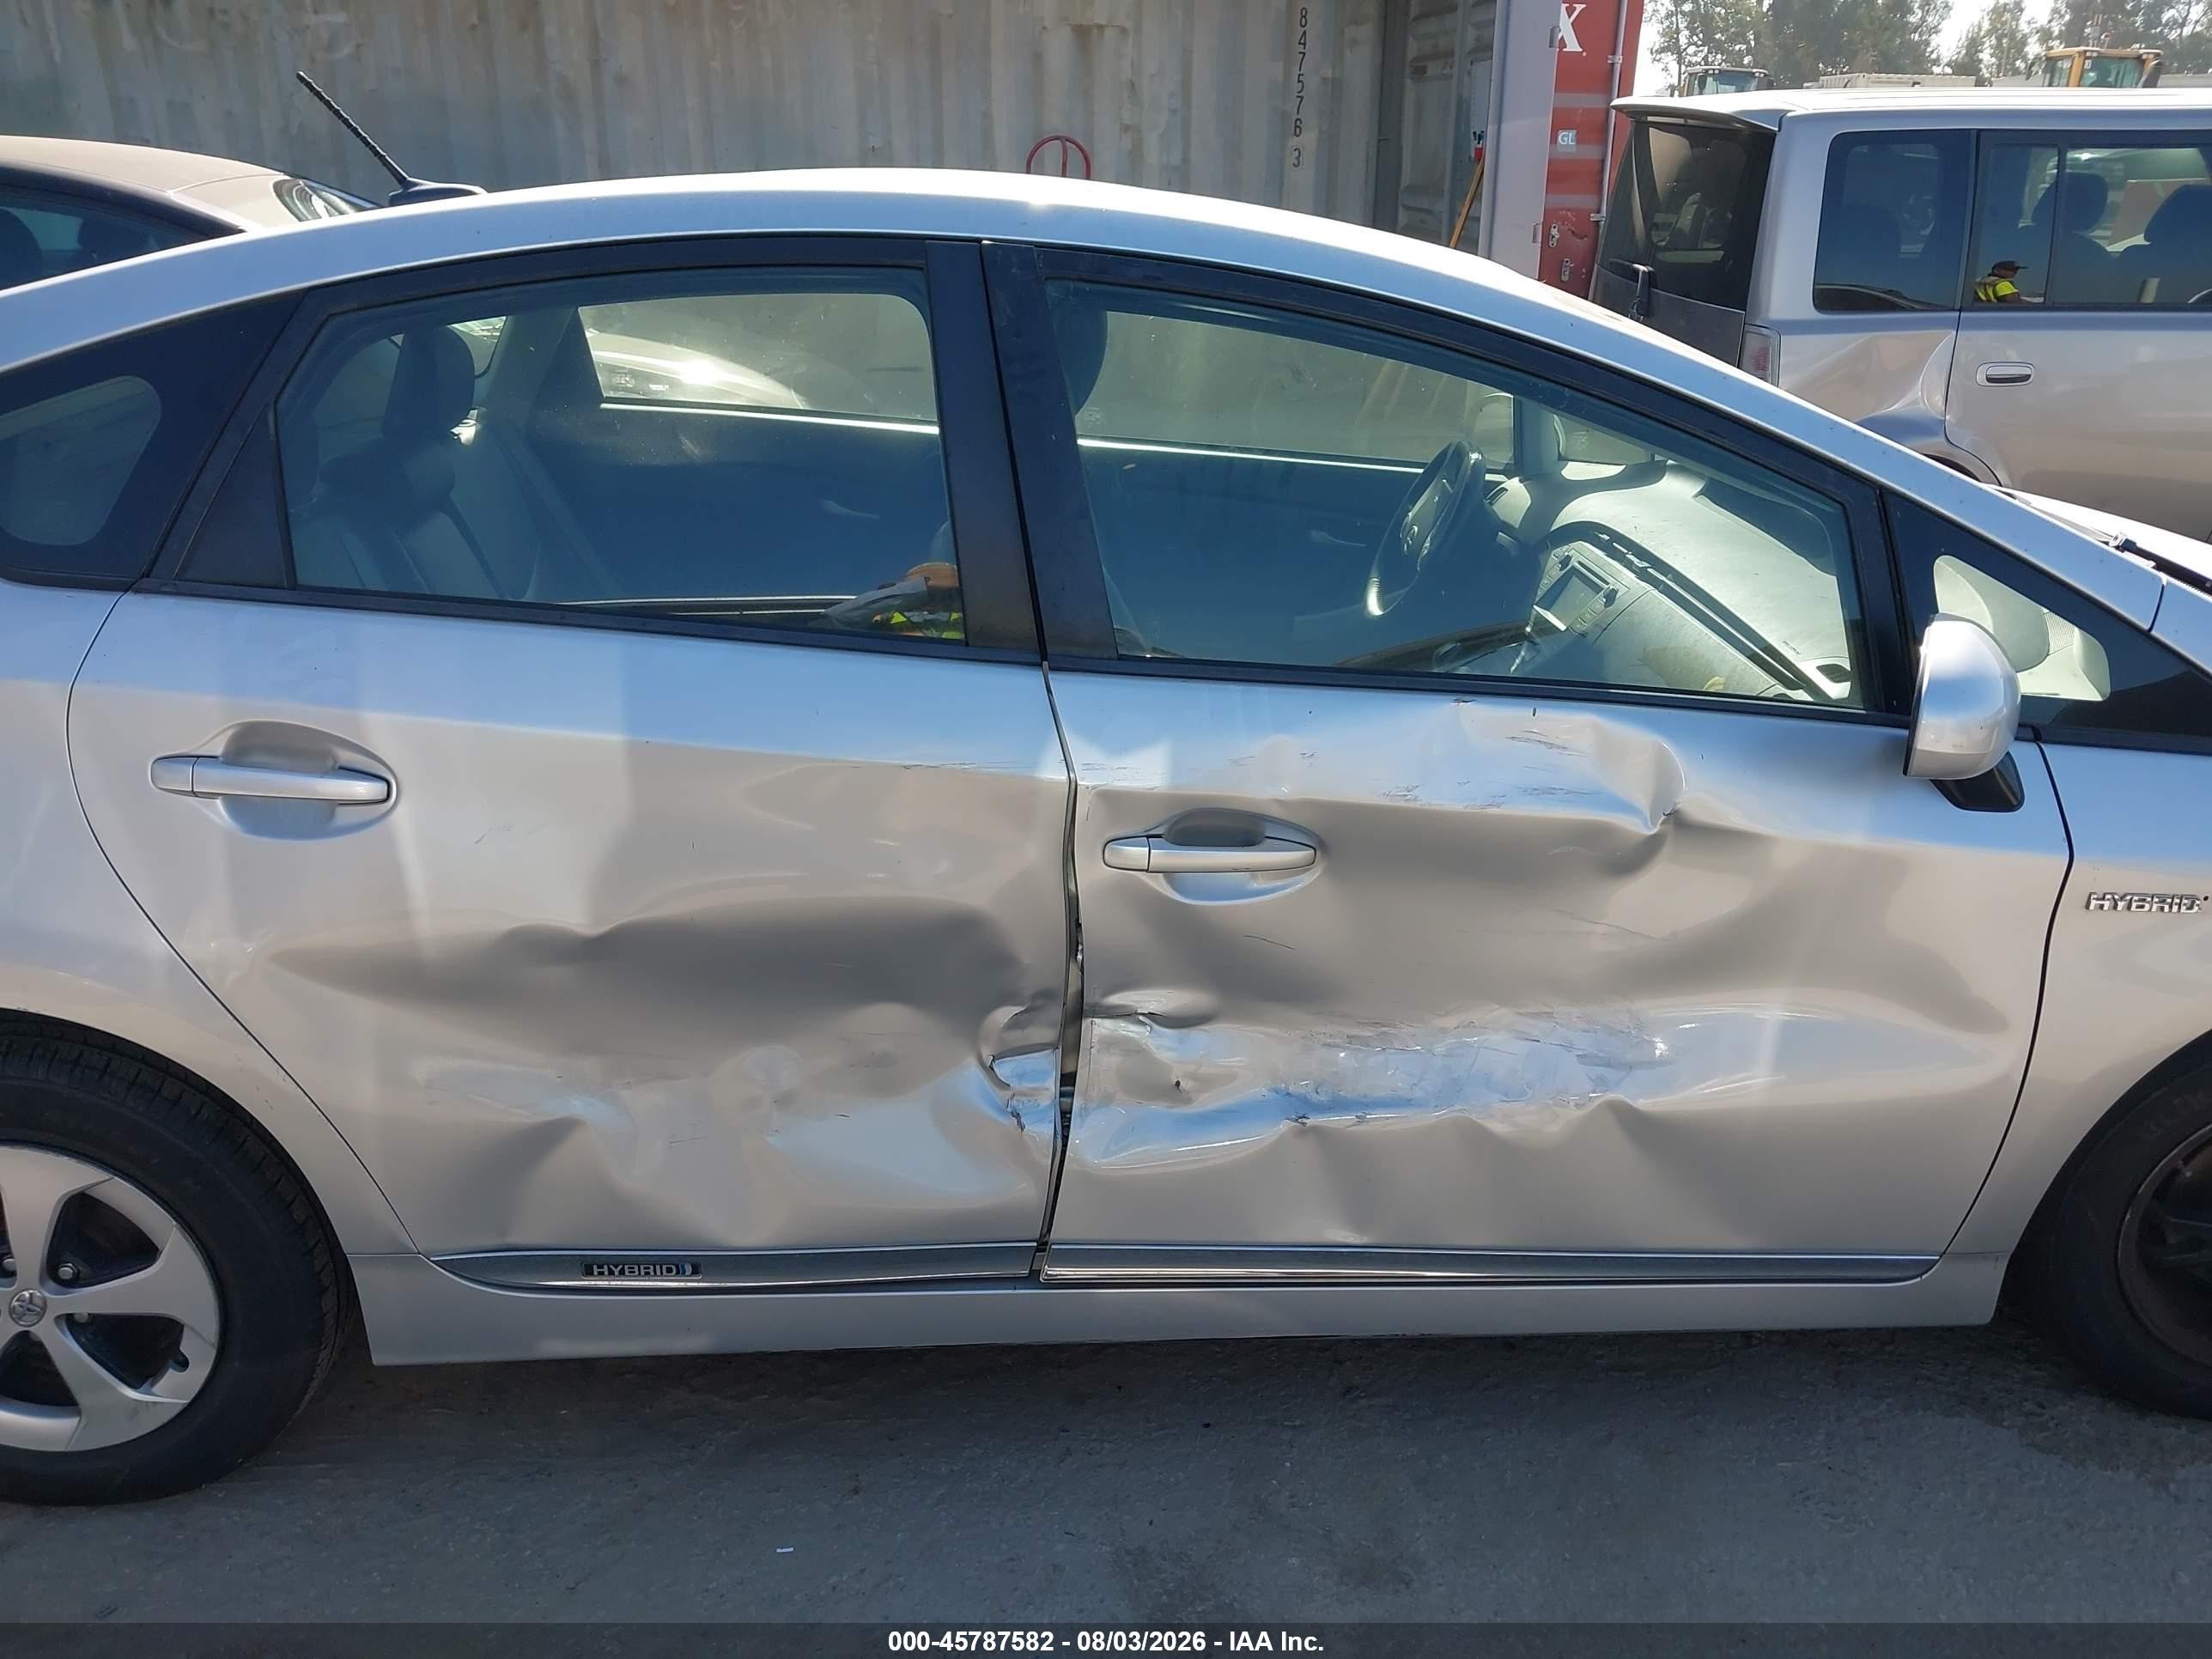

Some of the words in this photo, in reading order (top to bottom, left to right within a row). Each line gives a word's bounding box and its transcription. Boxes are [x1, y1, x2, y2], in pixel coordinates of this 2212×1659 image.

[1557, 3, 1587, 52] X
[1292, 7, 1309, 138] 847576
[1559, 131, 1577, 145] GL
[1291, 147, 1302, 168] 3
[2087, 892, 2202, 914] HYBRID
[592, 1264, 676, 1276] HYBRID
